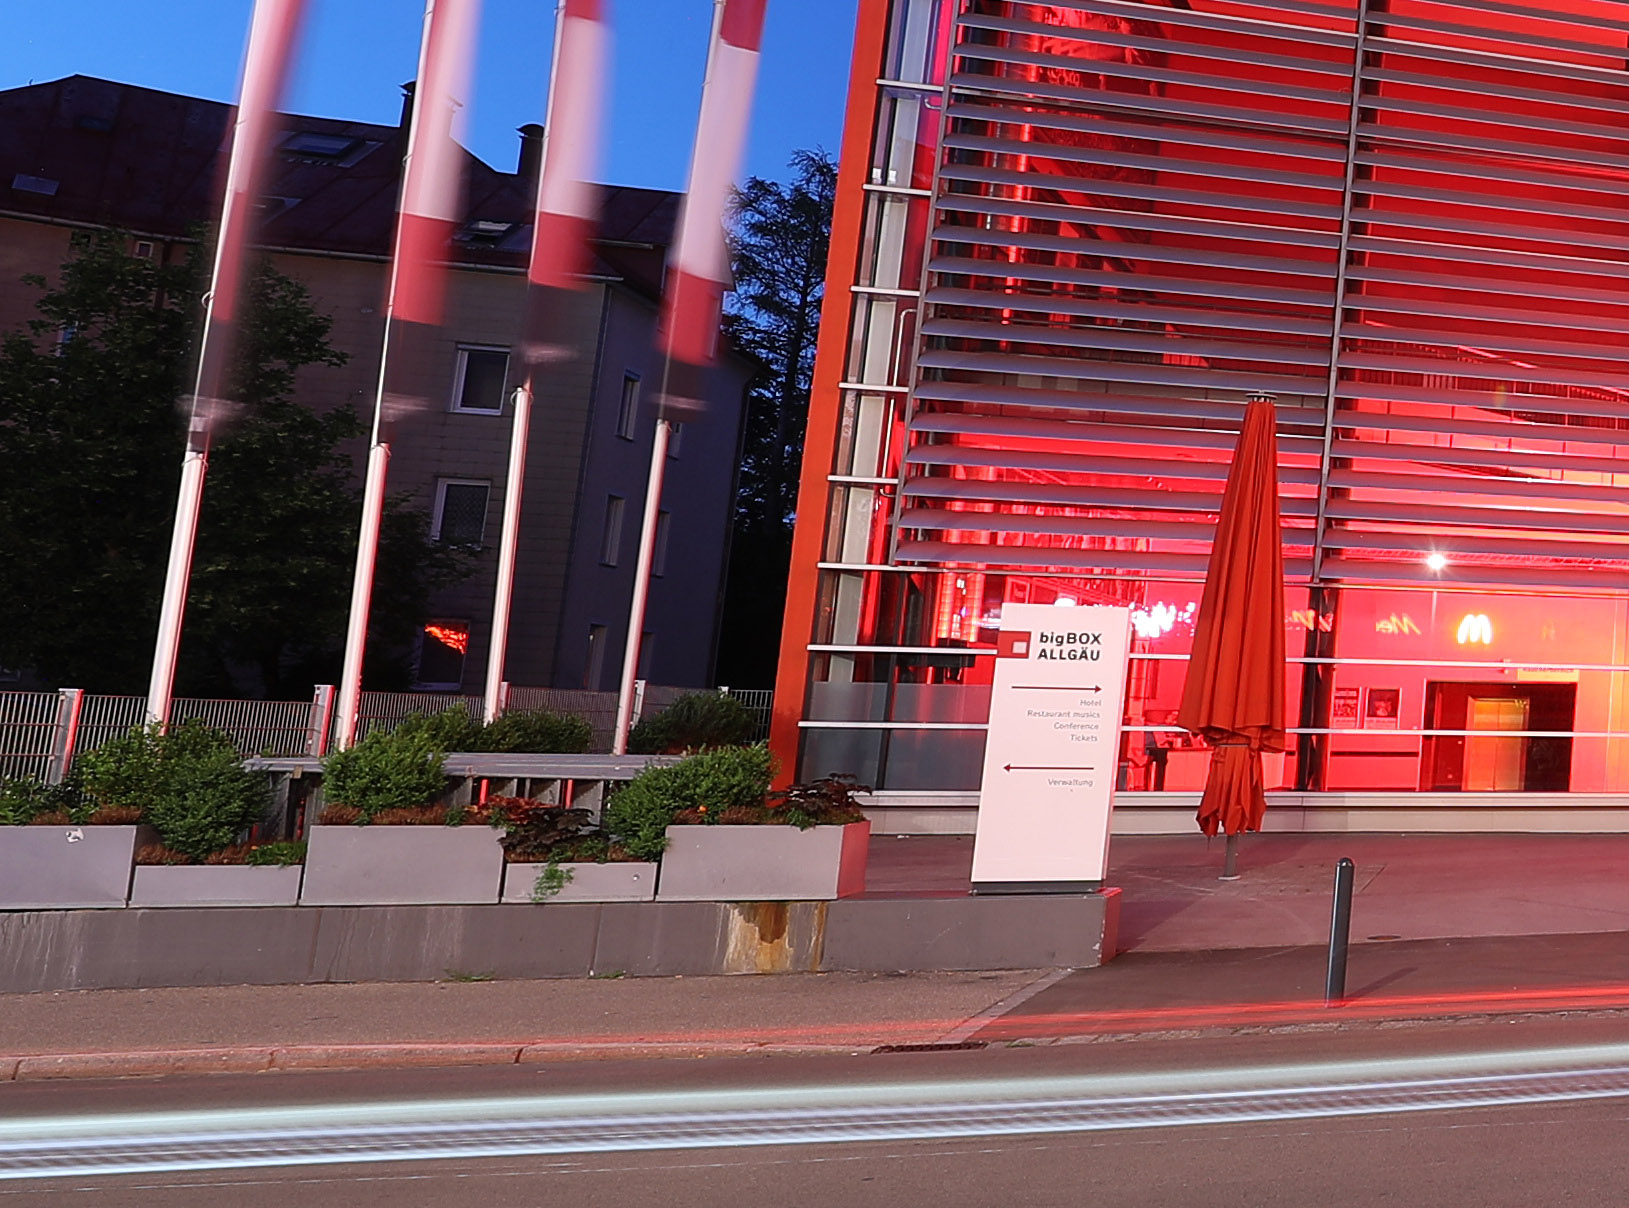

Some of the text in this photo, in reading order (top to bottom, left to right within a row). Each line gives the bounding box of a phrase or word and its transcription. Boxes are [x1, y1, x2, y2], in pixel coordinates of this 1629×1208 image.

[1039, 632, 1102, 646] bigBOX
[1038, 647, 1101, 662] ALLGÄU
[1027, 710, 1071, 718] Restaurant
[1054, 722, 1099, 730] Conference
[1070, 734, 1098, 742] Tickets
[1048, 778, 1094, 788] Verwaltung
